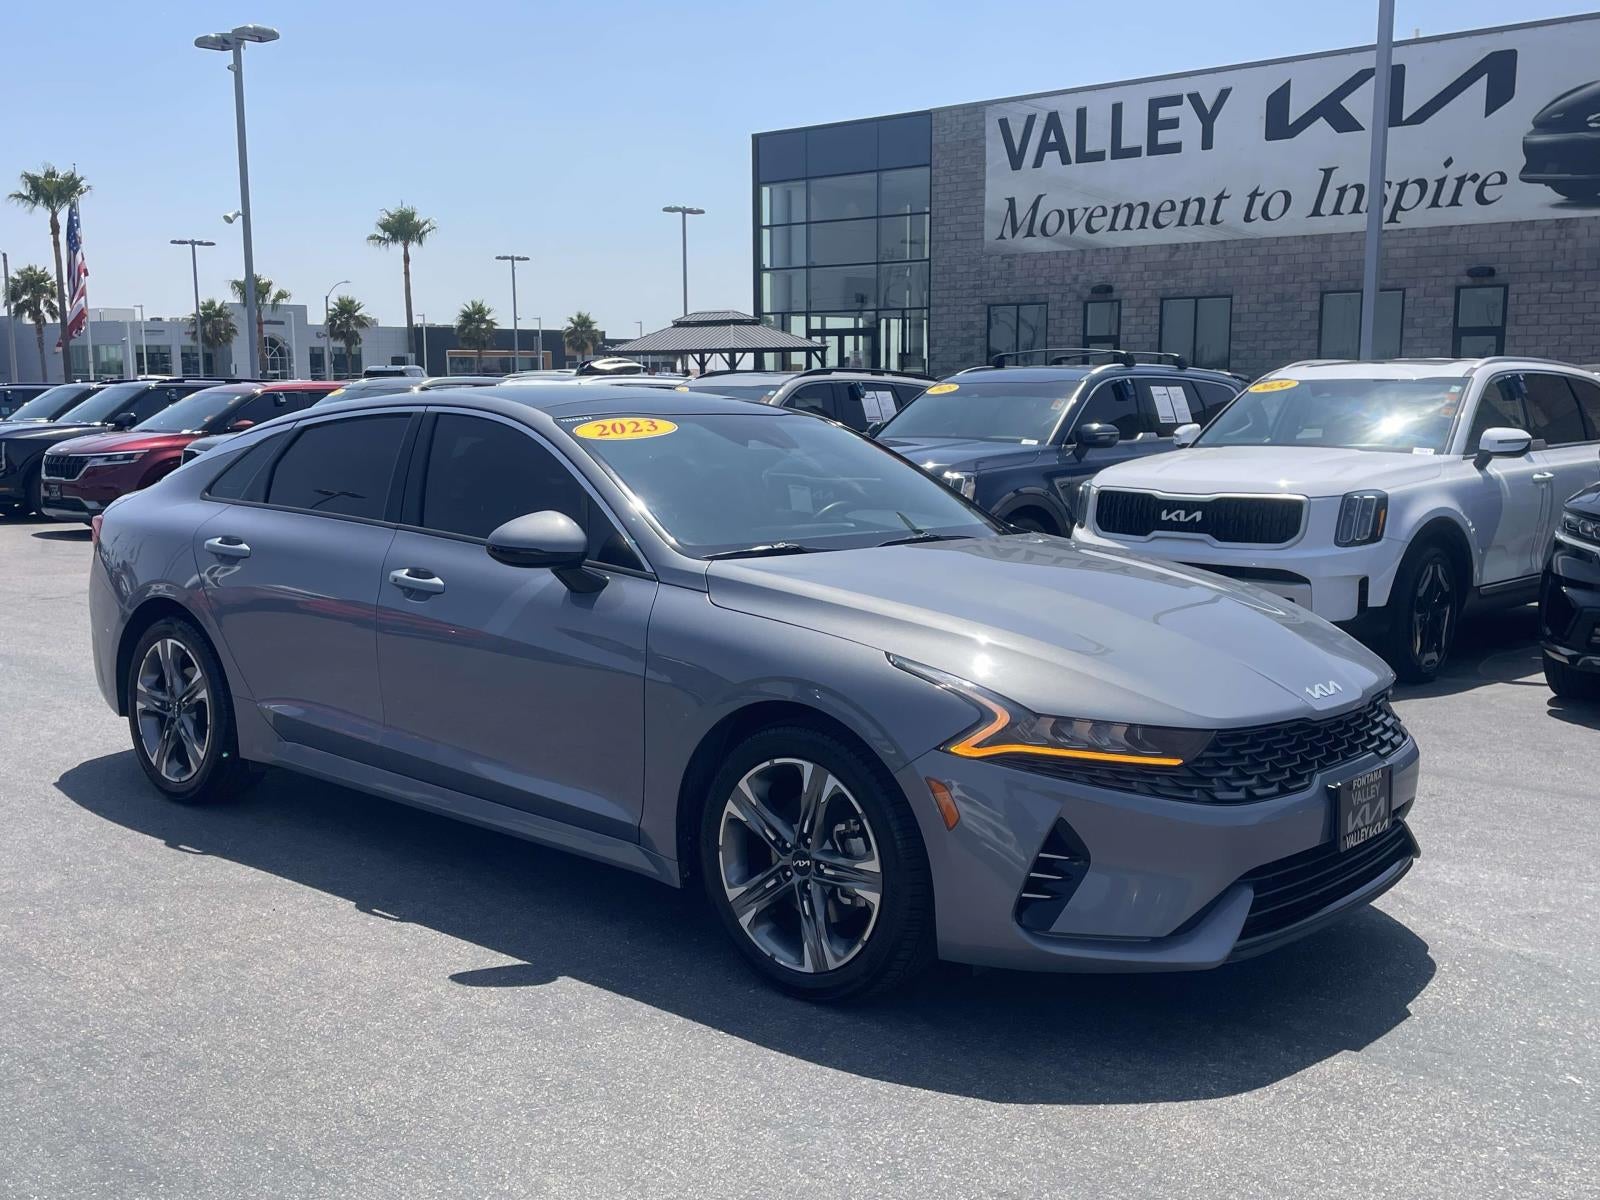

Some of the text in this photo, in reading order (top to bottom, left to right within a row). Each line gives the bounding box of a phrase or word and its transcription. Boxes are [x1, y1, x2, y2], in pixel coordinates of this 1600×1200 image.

[997, 48, 1518, 171] VALLEY KIA
[995, 186, 1232, 241] Movement
[1243, 184, 1292, 223] to
[594, 420, 658, 437] 2023
[1161, 509, 1203, 522] KIA
[1305, 680, 1343, 699] KIA
[1353, 769, 1383, 791] FONTANA
[1352, 783, 1380, 806] VALLEY
[1348, 797, 1385, 833] KIA
[1346, 818, 1389, 849] VALLEY KIA
